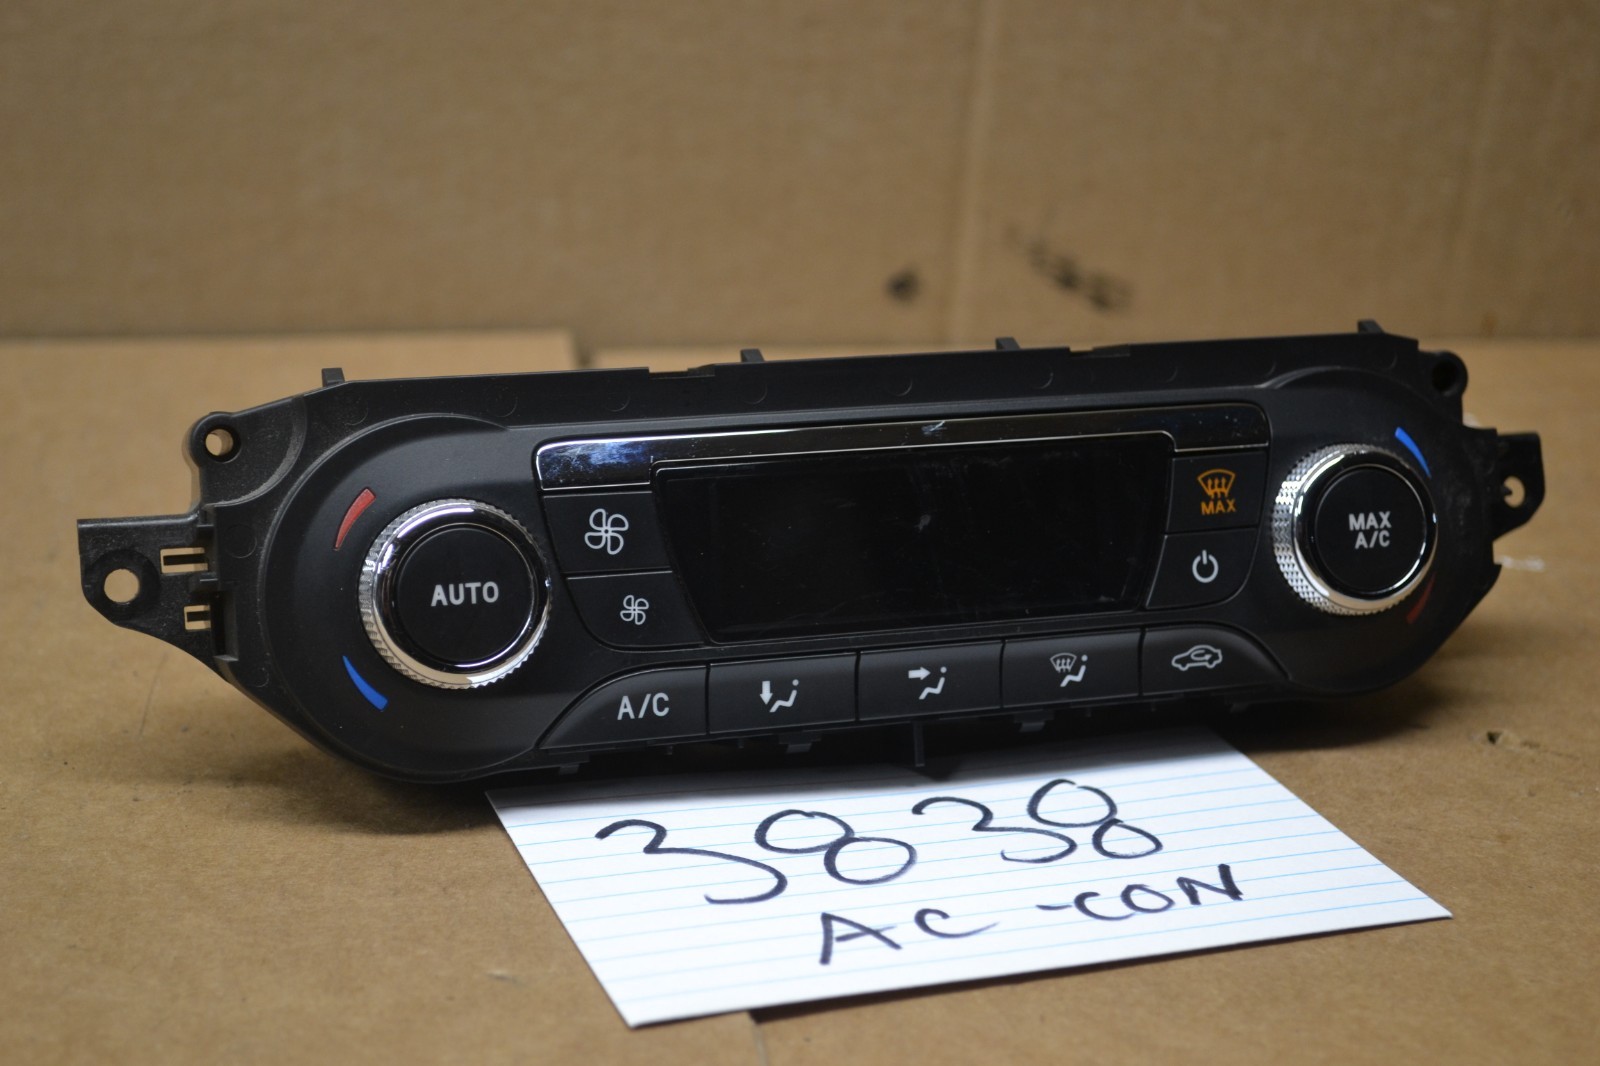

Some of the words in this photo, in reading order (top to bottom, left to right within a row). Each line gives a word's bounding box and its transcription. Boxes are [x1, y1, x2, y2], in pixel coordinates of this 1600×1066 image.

[1201, 499, 1236, 515] MAX
[1348, 511, 1392, 531] MAX
[1355, 530, 1390, 549] A/C
[430, 580, 500, 608] AUTO
[617, 692, 671, 721] A/C
[595, 778, 1164, 905] 3838
